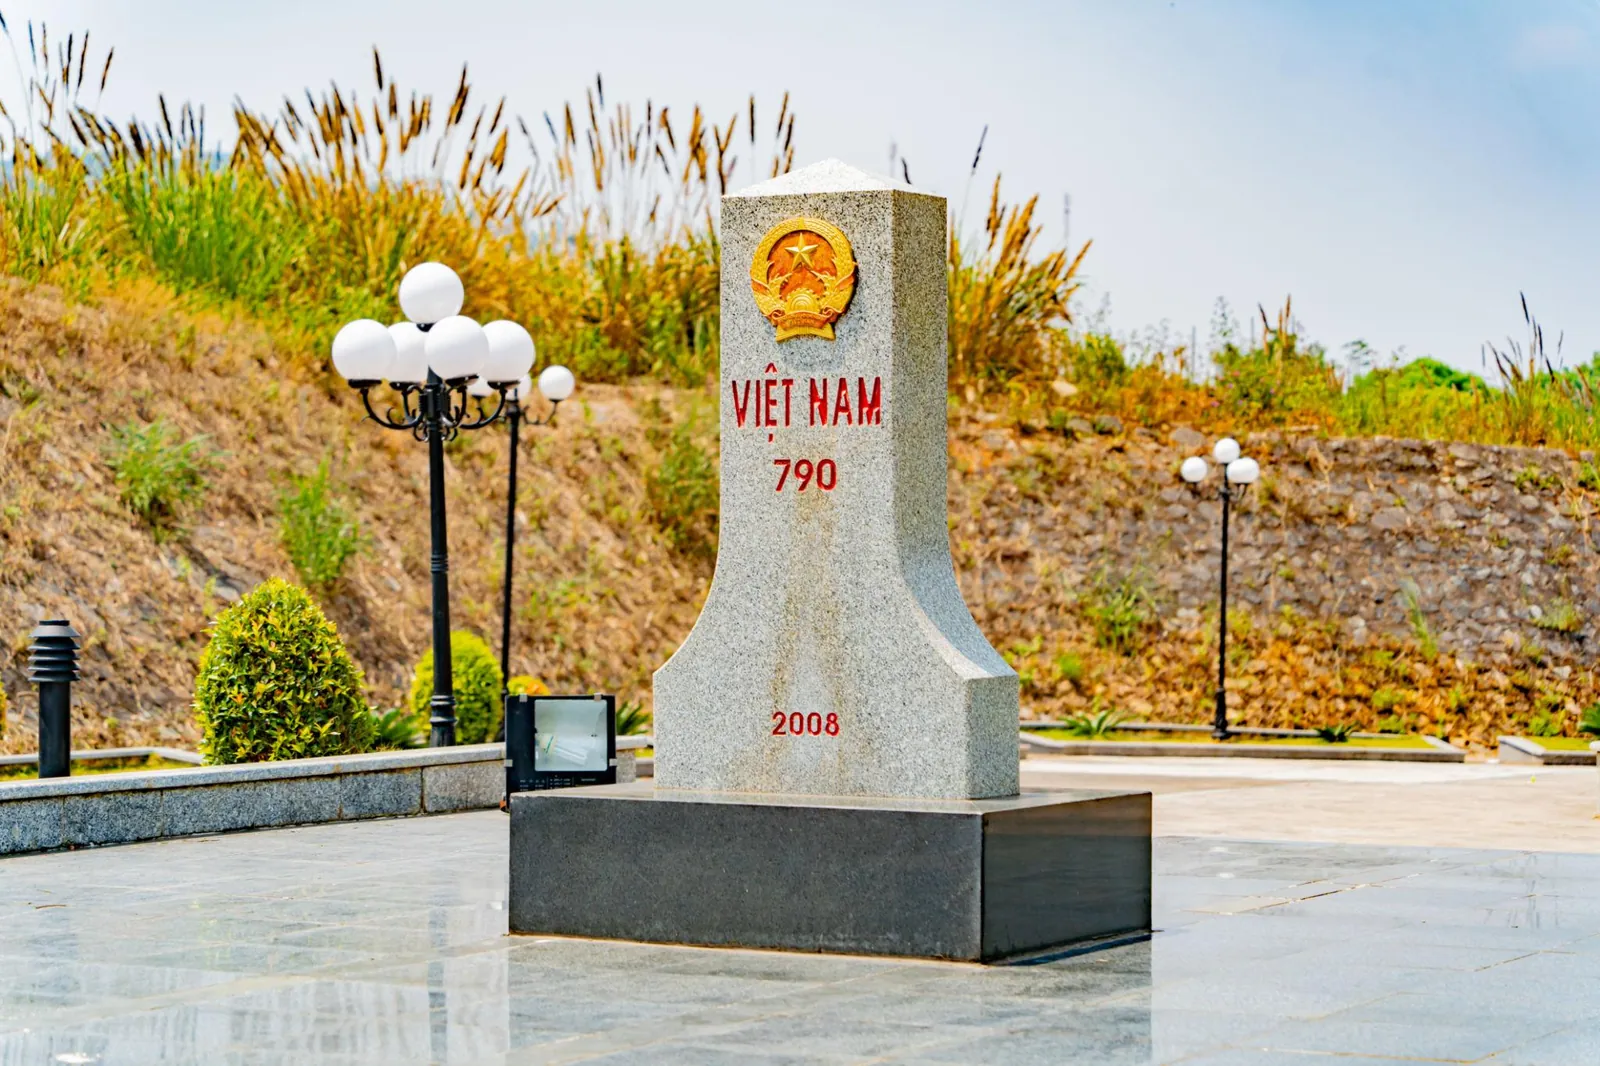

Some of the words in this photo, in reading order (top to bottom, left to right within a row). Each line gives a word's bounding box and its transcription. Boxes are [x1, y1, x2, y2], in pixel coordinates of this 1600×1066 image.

[732, 362, 794, 443] VIỆT
[809, 376, 882, 428] NAM
[773, 458, 837, 493] 790
[771, 711, 841, 737] 2008
